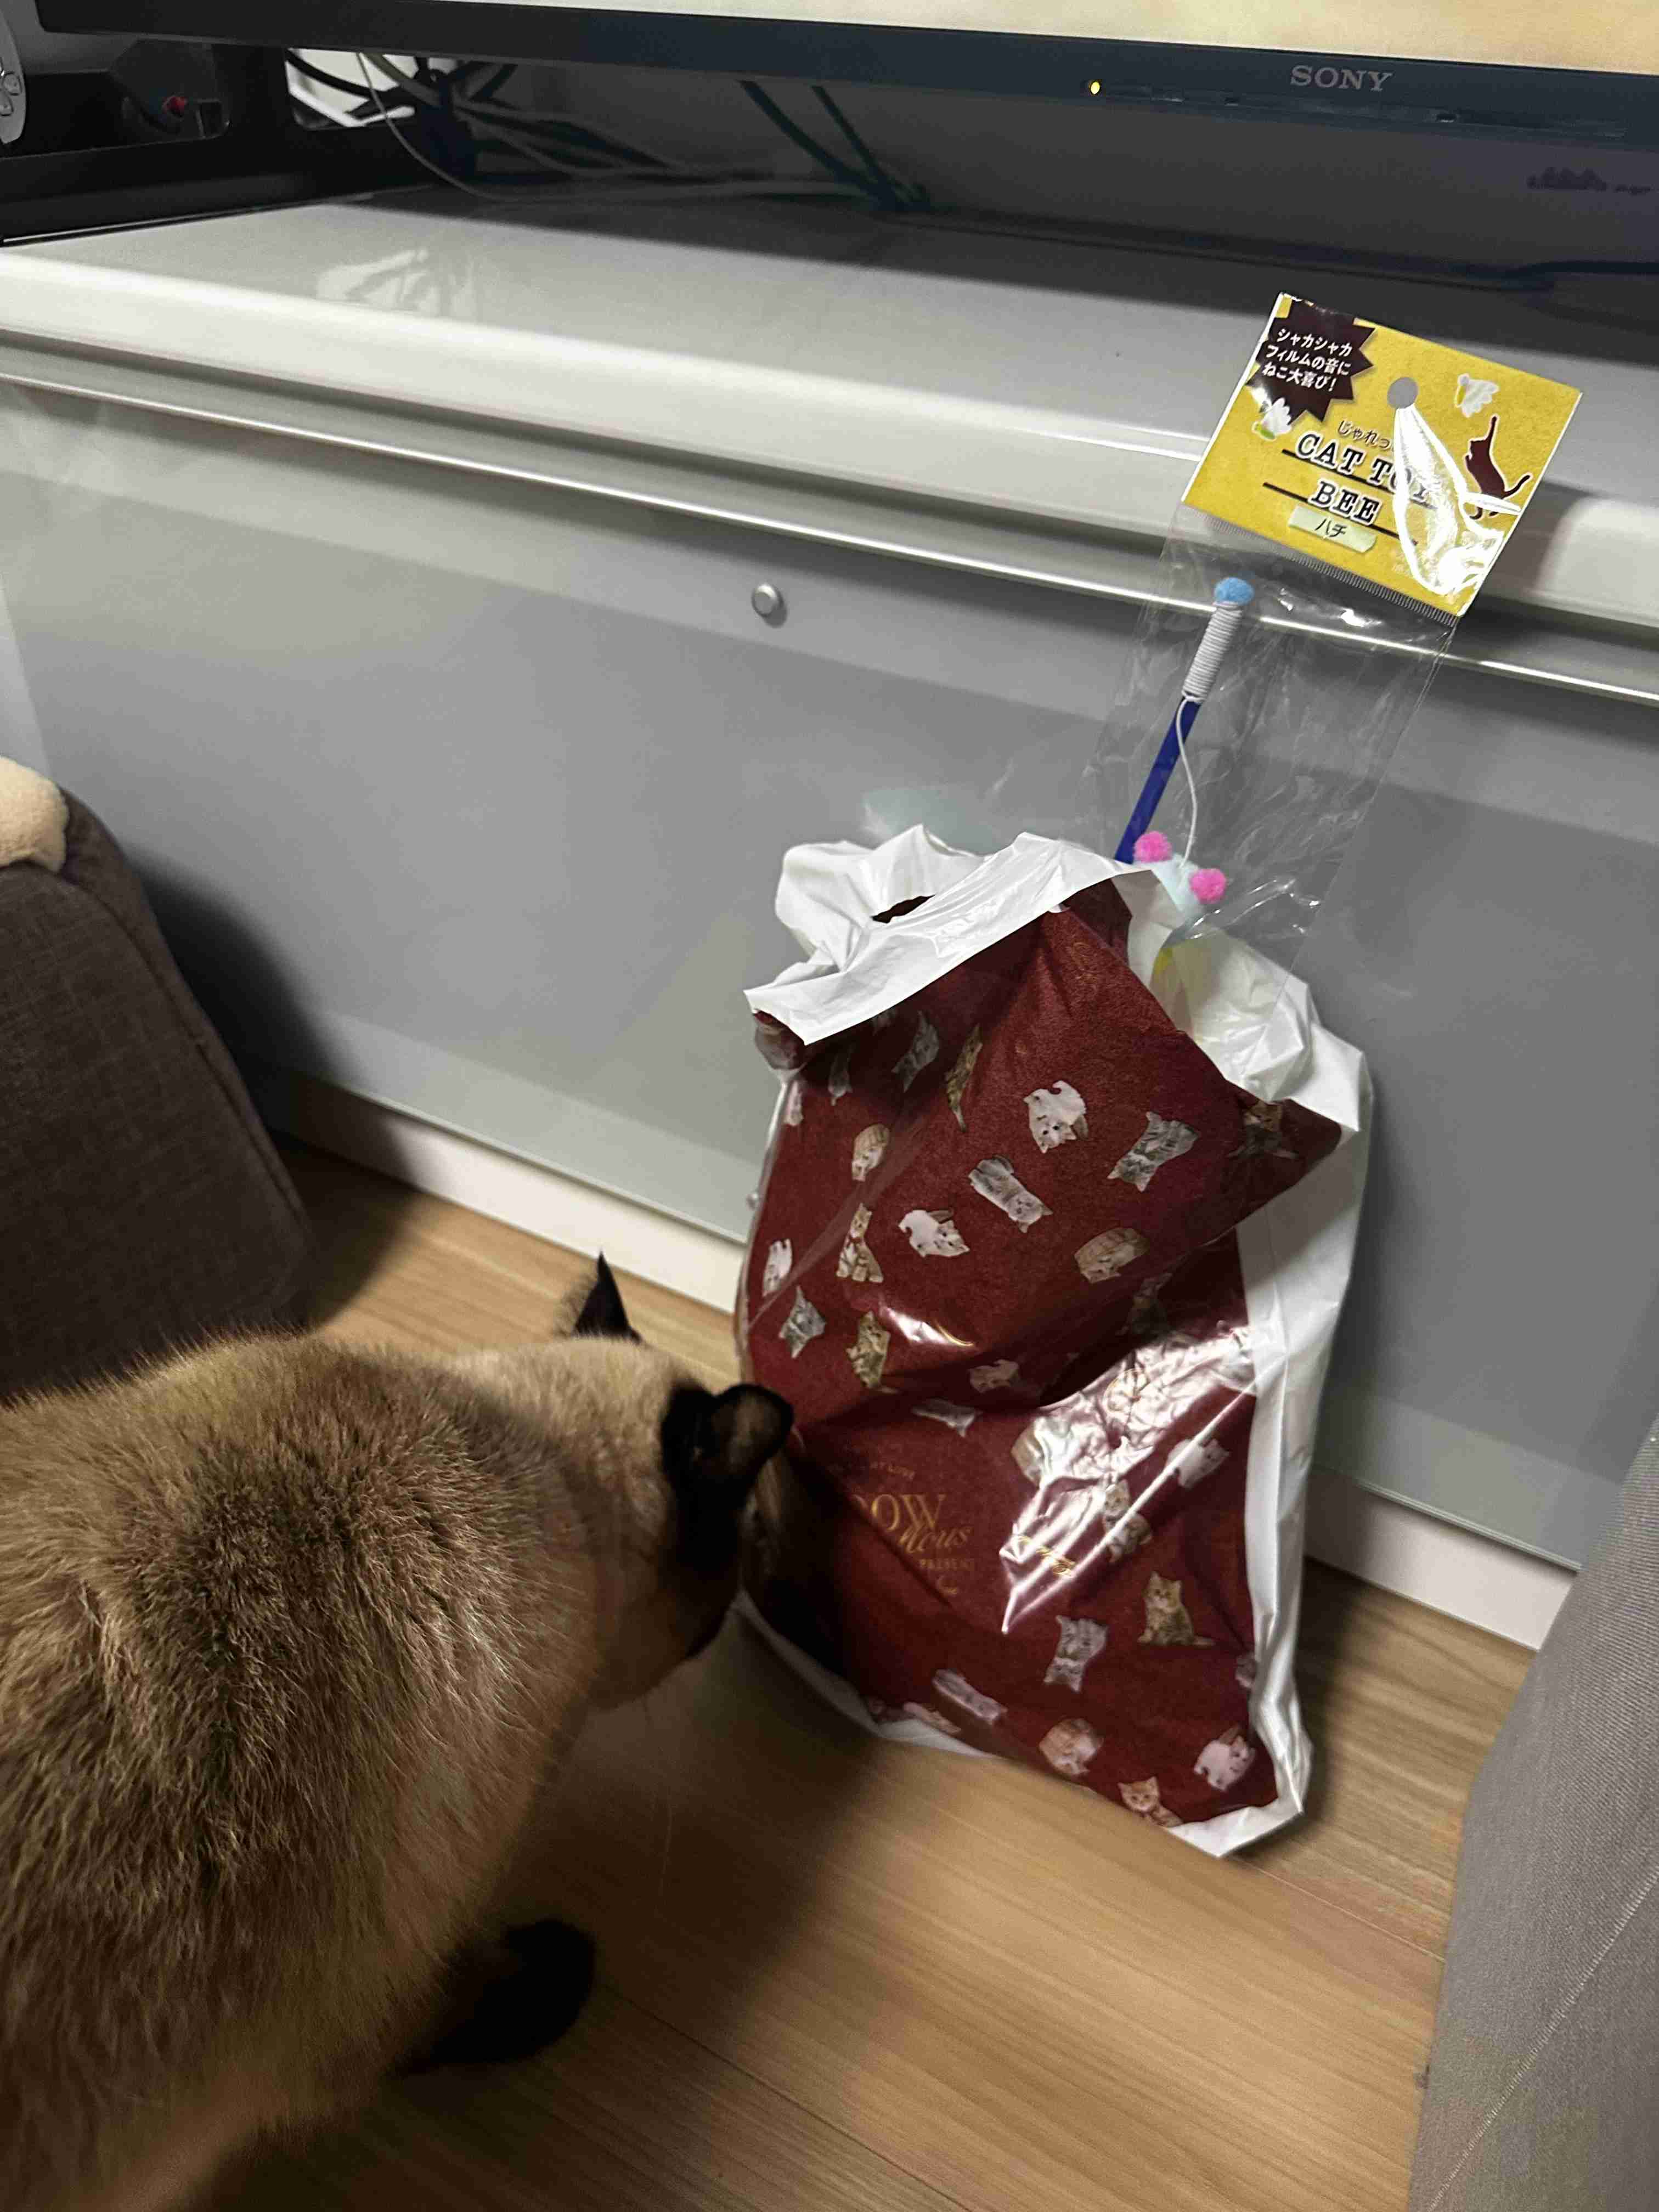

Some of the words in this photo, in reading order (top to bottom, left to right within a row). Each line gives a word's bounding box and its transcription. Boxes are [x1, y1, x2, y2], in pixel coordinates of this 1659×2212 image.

[1290, 65, 1393, 92] SONY
[1277, 328, 1352, 357] シャカシャカ
[1266, 344, 1352, 376] フィルムの音に
[1262, 361, 1337, 392] ねこ大喜び！
[1337, 420, 1396, 452] じゃれっ
[1296, 433, 1364, 473] CAT
[1311, 480, 1380, 523] BEE
[1314, 517, 1347, 538] ハチ
